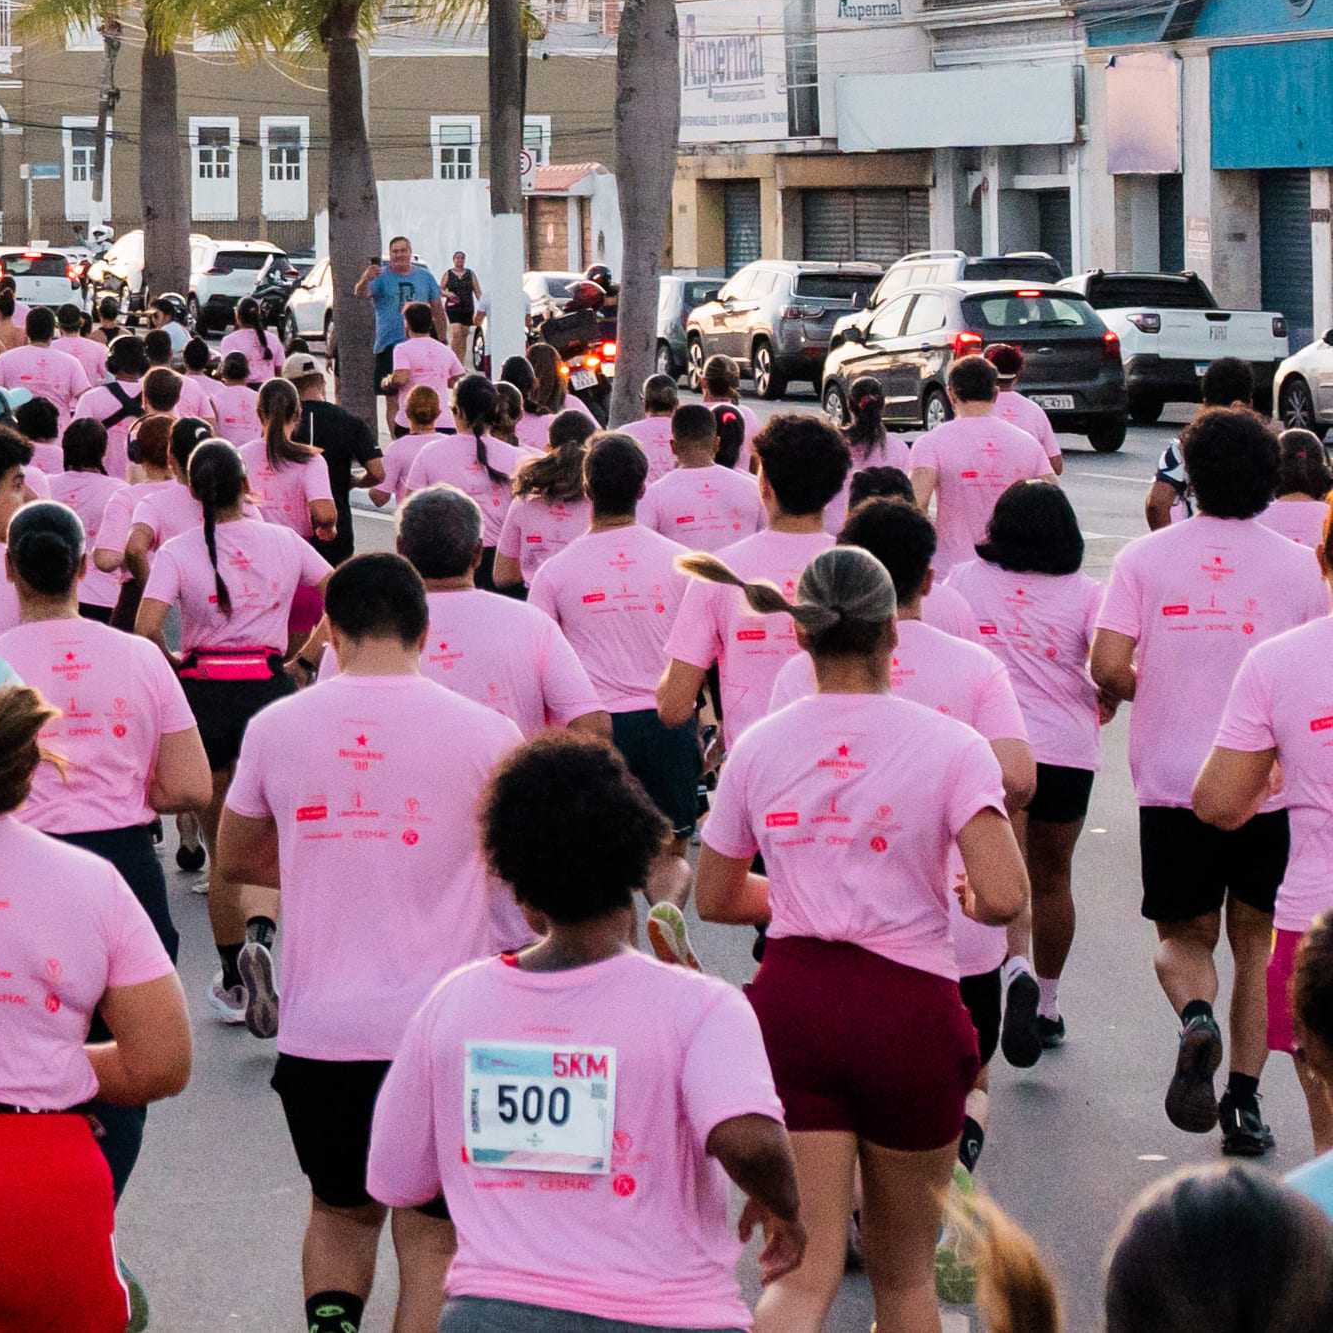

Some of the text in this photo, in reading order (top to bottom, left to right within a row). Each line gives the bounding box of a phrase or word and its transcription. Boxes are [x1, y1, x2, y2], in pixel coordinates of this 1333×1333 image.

[838, 0, 902, 20] Ampermal
[553, 1052, 608, 1079] 5KM
[497, 1084, 571, 1127] 500
